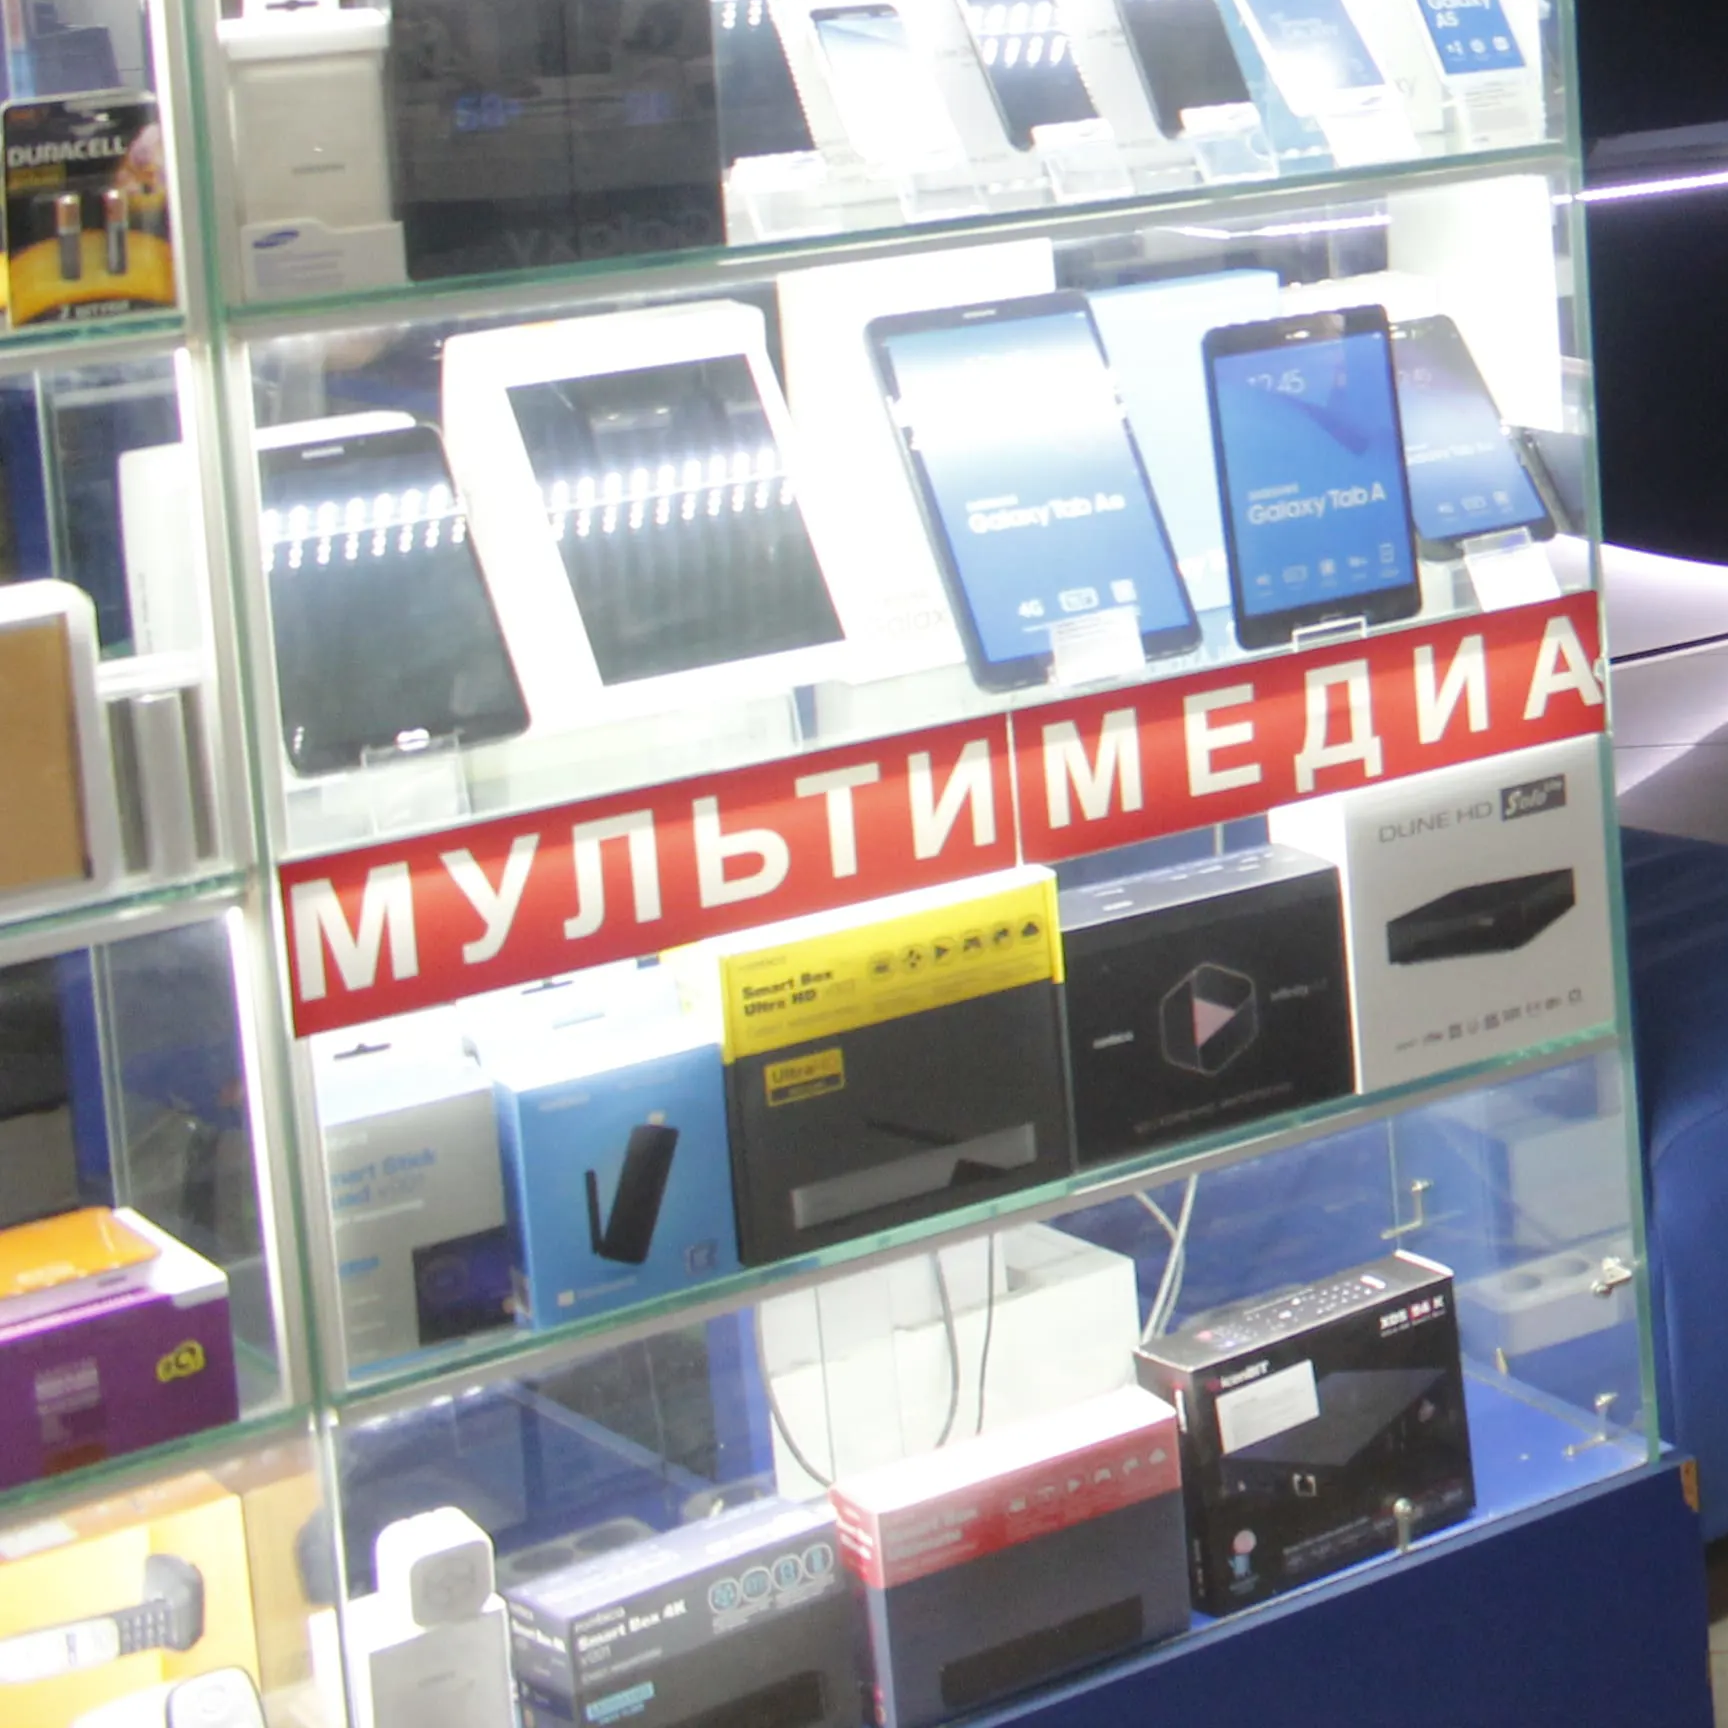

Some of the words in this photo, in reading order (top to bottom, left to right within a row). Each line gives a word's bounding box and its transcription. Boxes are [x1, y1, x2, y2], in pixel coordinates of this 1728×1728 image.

[7, 136, 127, 167] DURACELL
[1248, 497, 1325, 526] Galaxy
[1326, 485, 1368, 511] Tab
[1371, 480, 1386, 502] A
[1456, 800, 1494, 825] HD
[742, 978, 795, 1001] Smart
[800, 969, 834, 987] Box
[743, 998, 786, 1018] Ultra
[791, 988, 817, 1006] HD
[578, 1622, 627, 1652] Smart
[629, 1612, 661, 1633] Box
[662, 1598, 688, 1621] 4K
